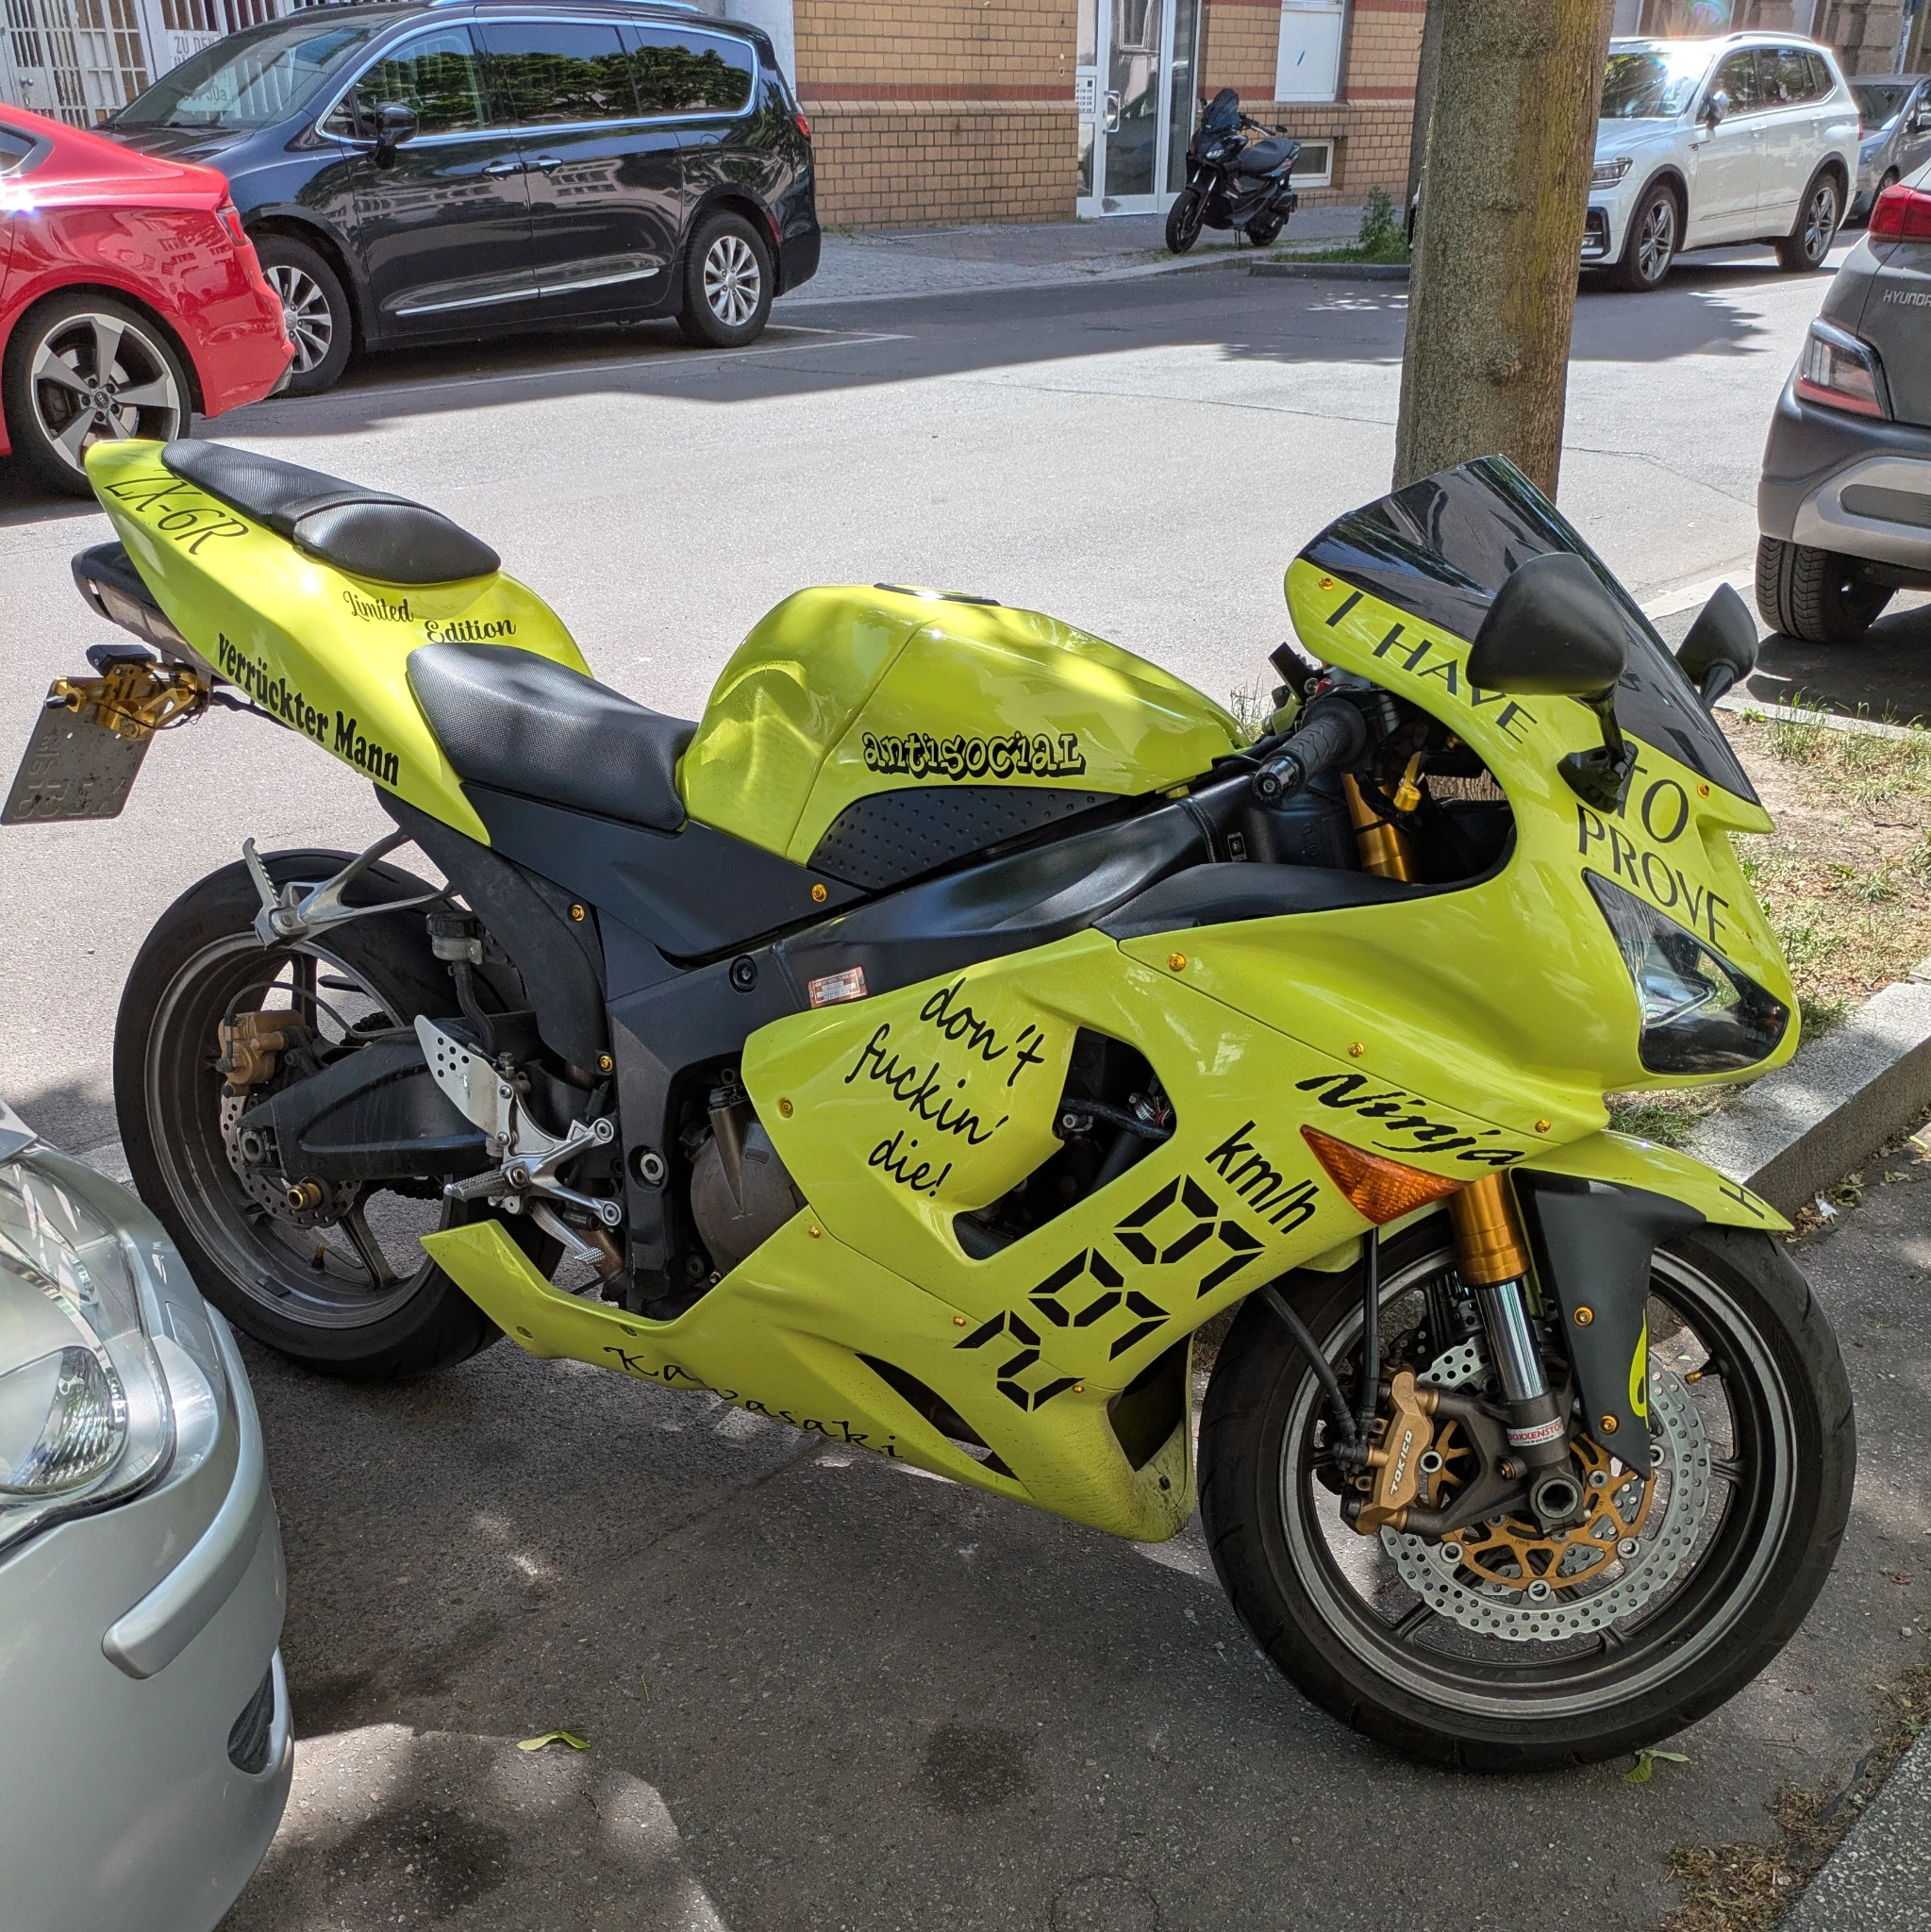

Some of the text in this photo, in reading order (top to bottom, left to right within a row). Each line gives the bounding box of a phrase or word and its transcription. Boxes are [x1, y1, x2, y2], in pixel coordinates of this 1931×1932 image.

[103, 469, 250, 556] ZX-6R
[342, 591, 414, 623] Limited
[424, 619, 517, 643] Edition
[218, 632, 400, 787] verrückter Mann
[1324, 591, 1538, 744] I HAVE
[1617, 762, 1690, 844] TO
[1576, 803, 1730, 957] PROVE
[919, 976, 1045, 1087] don't
[844, 1023, 1009, 1145] fuckin'
[1294, 1073, 1526, 1166] Ninja
[868, 1129, 953, 1198] die!
[1204, 1120, 1321, 1235] km/h
[1390, 1429, 1413, 1495] TOKICO
